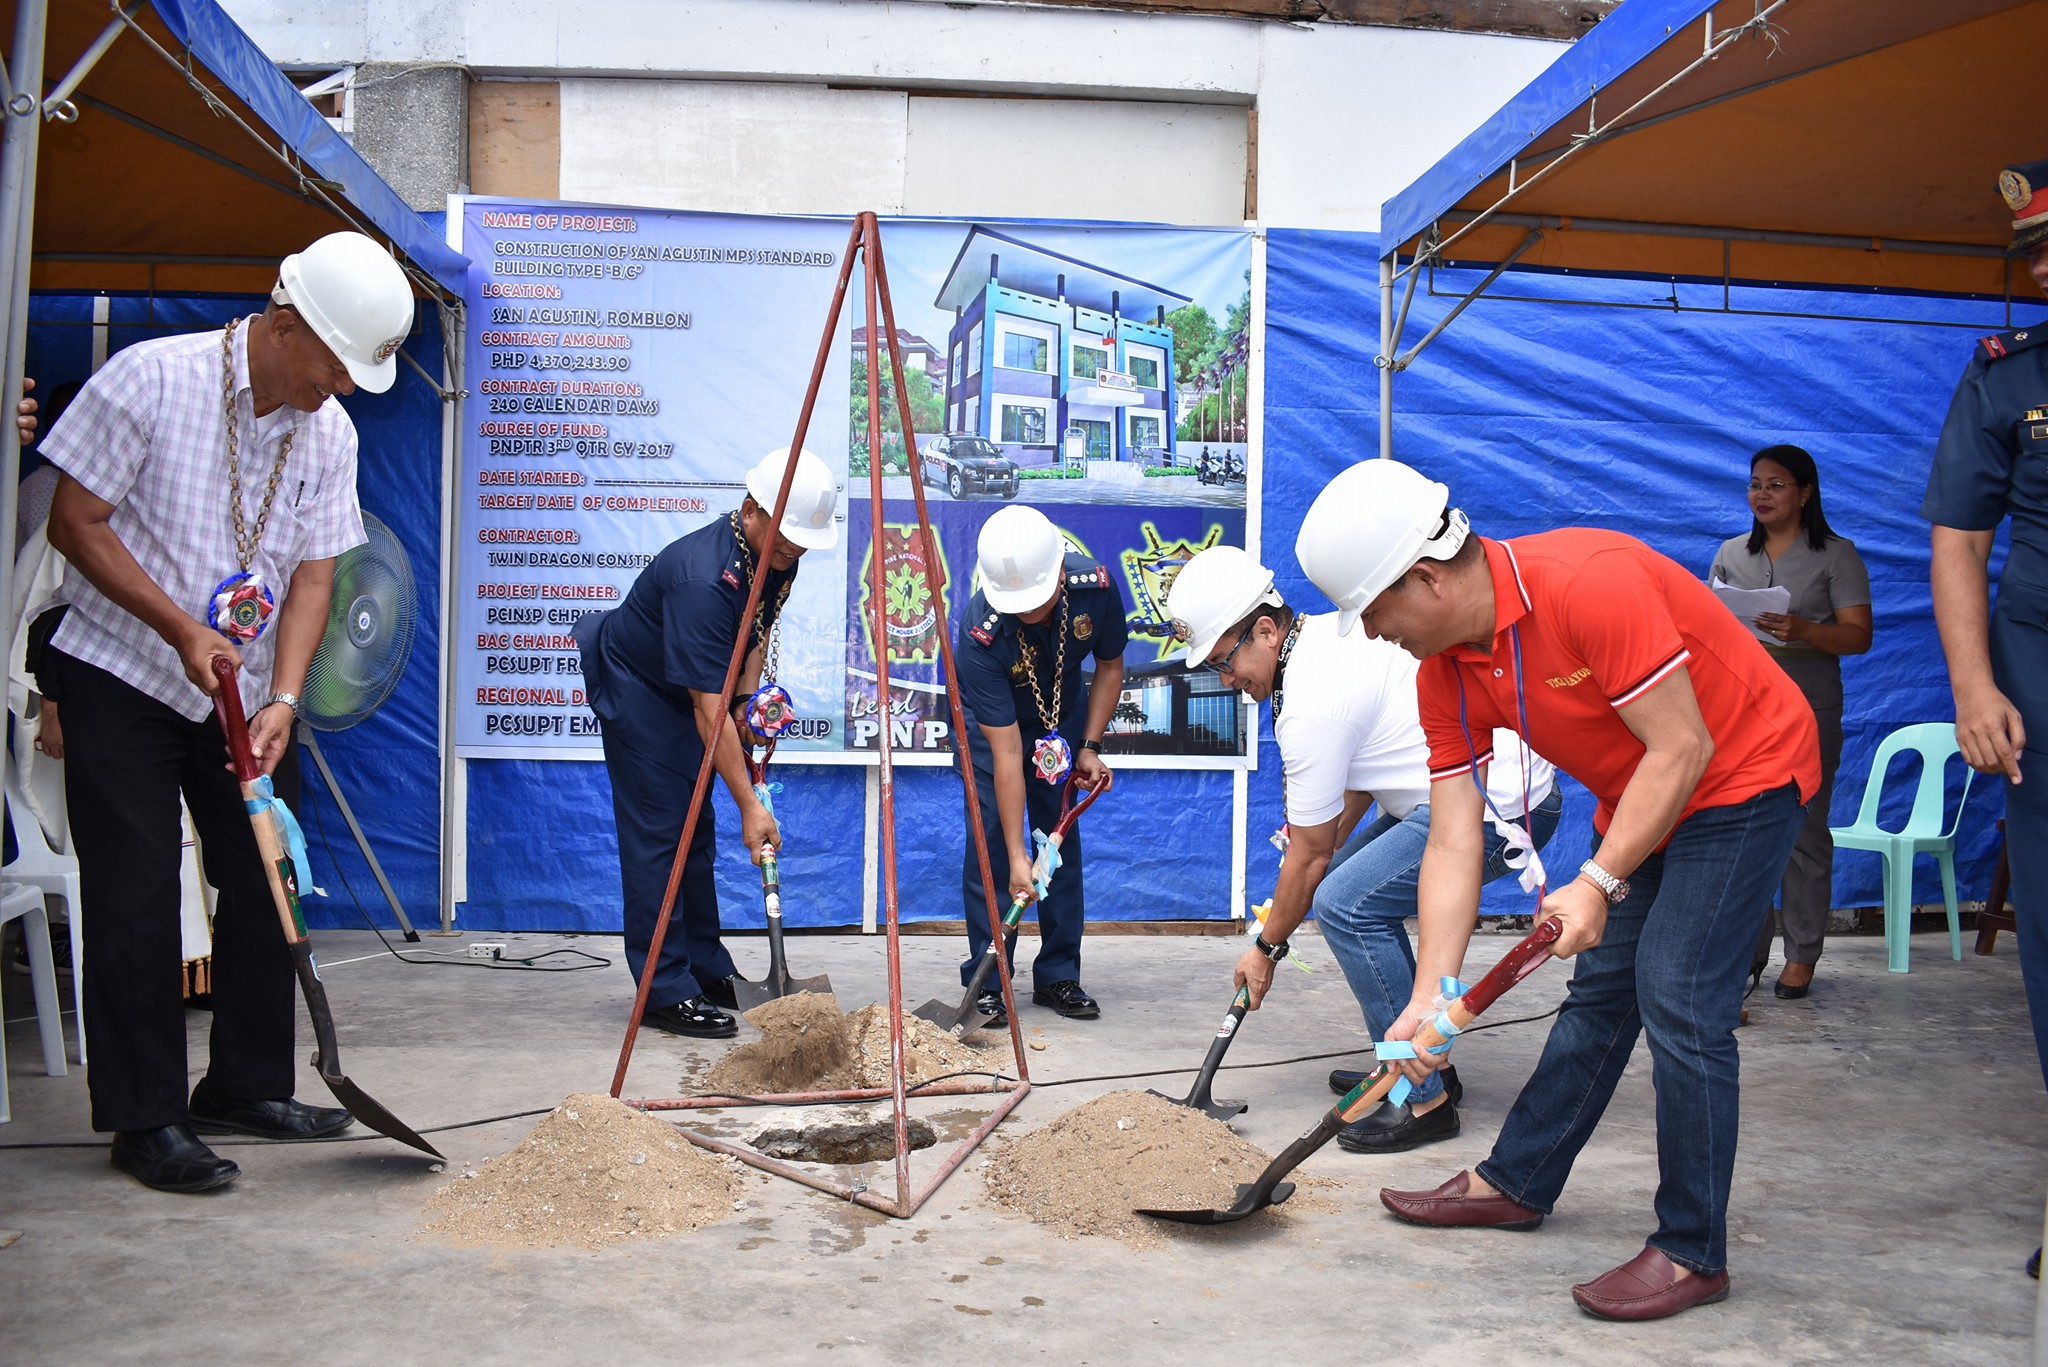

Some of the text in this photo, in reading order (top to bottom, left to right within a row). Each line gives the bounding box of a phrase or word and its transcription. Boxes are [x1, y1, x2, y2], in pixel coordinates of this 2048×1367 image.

[482, 213, 636, 232] NAME OF PROJECT:
[495, 241, 834, 266] CONSTRUCTION OF SAN AGUSTIN MPS STANDARD
[493, 260, 563, 276] BUILDING
[567, 263, 602, 277] TYPE
[482, 283, 561, 298] LOCATION:
[492, 307, 690, 329] SAN AGUSTIN, ROMBLON
[481, 332, 630, 348] CONTRACT AMOUNT:
[491, 352, 629, 371] PHP 4,370,243.90
[480, 380, 642, 396] CONTRACT DURATION:
[490, 398, 658, 415] 240 CALENDAR DAYS
[479, 422, 608, 438] SOURCE OF FUND:
[490, 439, 543, 455] PNPTR
[576, 441, 609, 457] QTR
[613, 442, 633, 457] CY
[637, 442, 672, 457] 2017
[479, 470, 586, 486] DATE STARTED:
[479, 494, 706, 512] TARGET DATE OF COMPLETION:
[478, 528, 578, 544] CONTRACTOR:
[487, 551, 657, 568] TWIN DRAGON CONSTR
[477, 584, 619, 600] PROJECT ENGINEER:
[487, 607, 543, 624] PCINSP
[476, 634, 579, 650] BAC CHAIRM
[1278, 629, 1295, 661] GoPro
[486, 656, 583, 674] PCSUPT FR
[476, 687, 566, 705] REGIONAL
[851, 690, 916, 718] Led
[486, 713, 603, 736] PCSUPT EM
[776, 718, 831, 739] CUP
[853, 720, 949, 749] PNP
